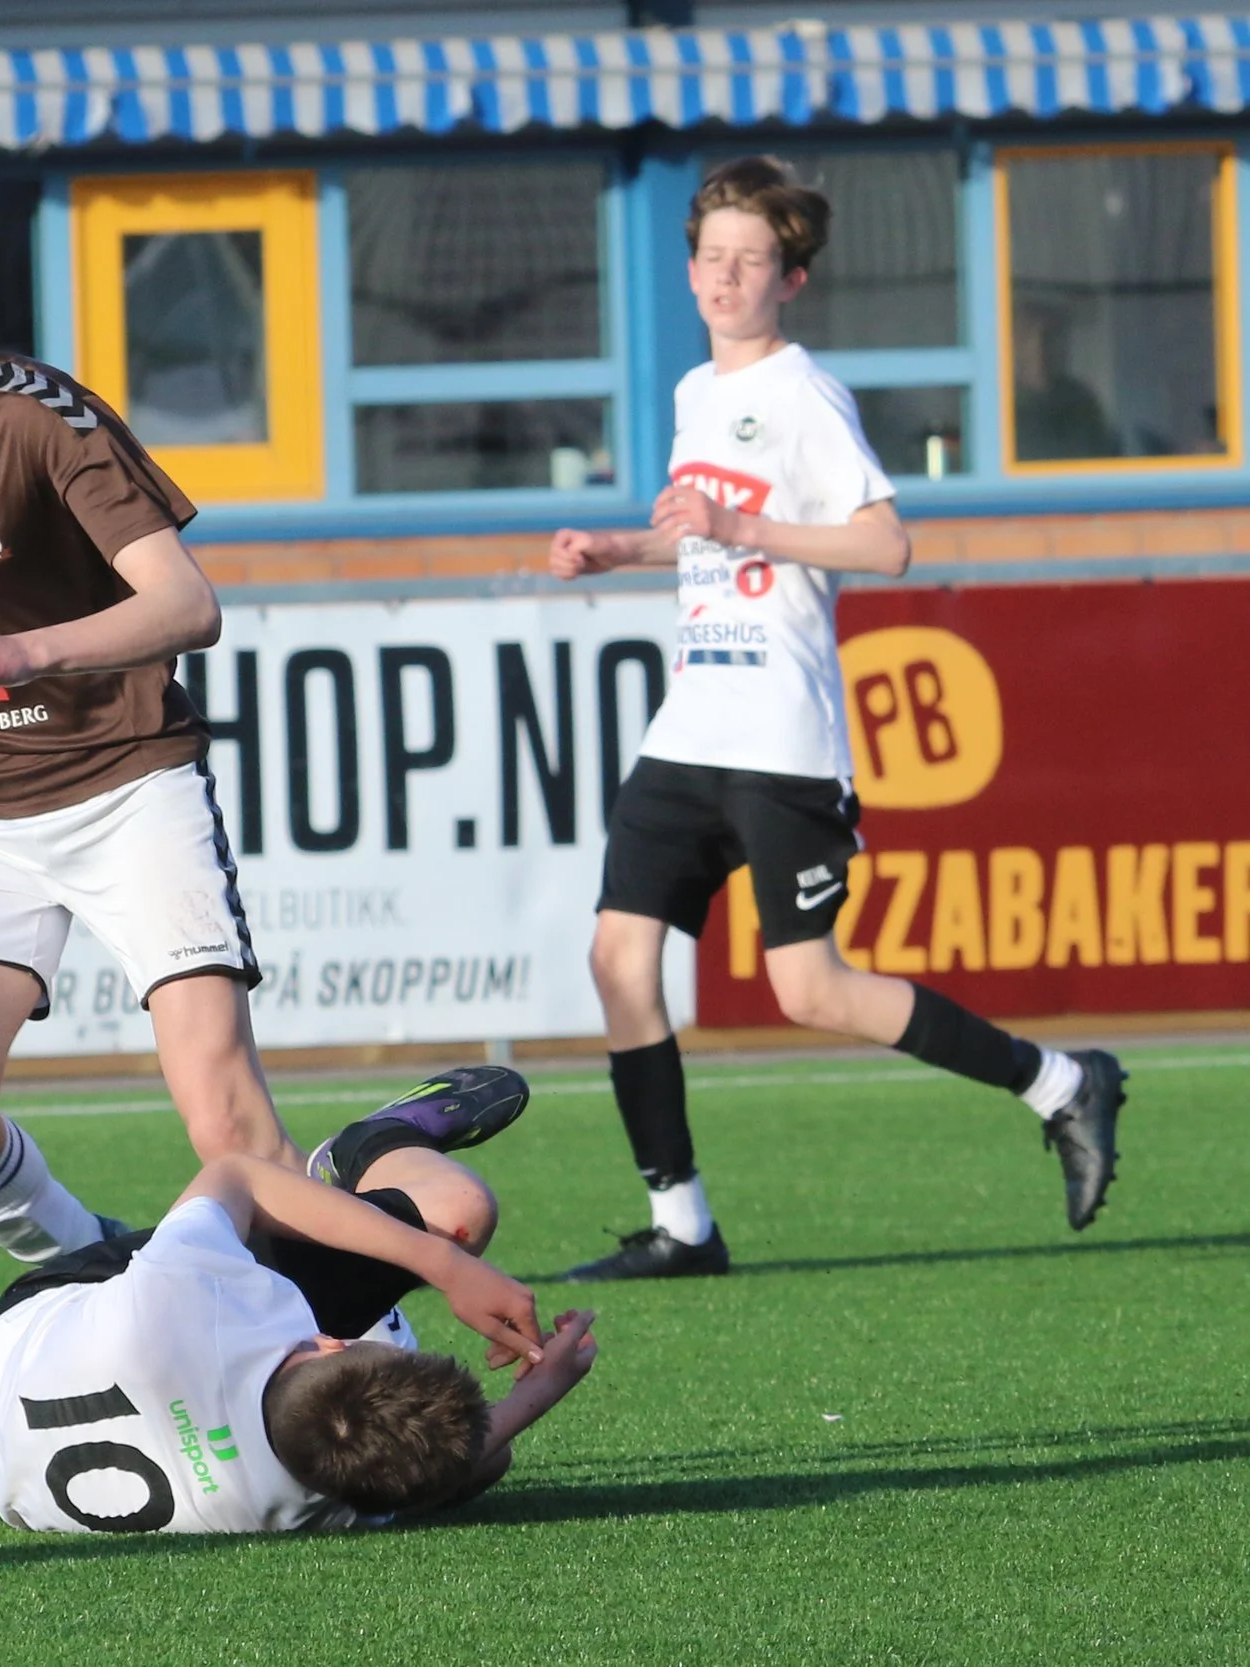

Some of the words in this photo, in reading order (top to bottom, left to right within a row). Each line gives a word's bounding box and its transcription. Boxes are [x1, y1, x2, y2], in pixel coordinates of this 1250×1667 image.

[855, 660, 958, 780] PB
[183, 940, 229, 957] hummel
[316, 953, 532, 1008] SKOPPUM!
[19, 1383, 175, 1532] 10
[169, 1399, 219, 1494] unisport
